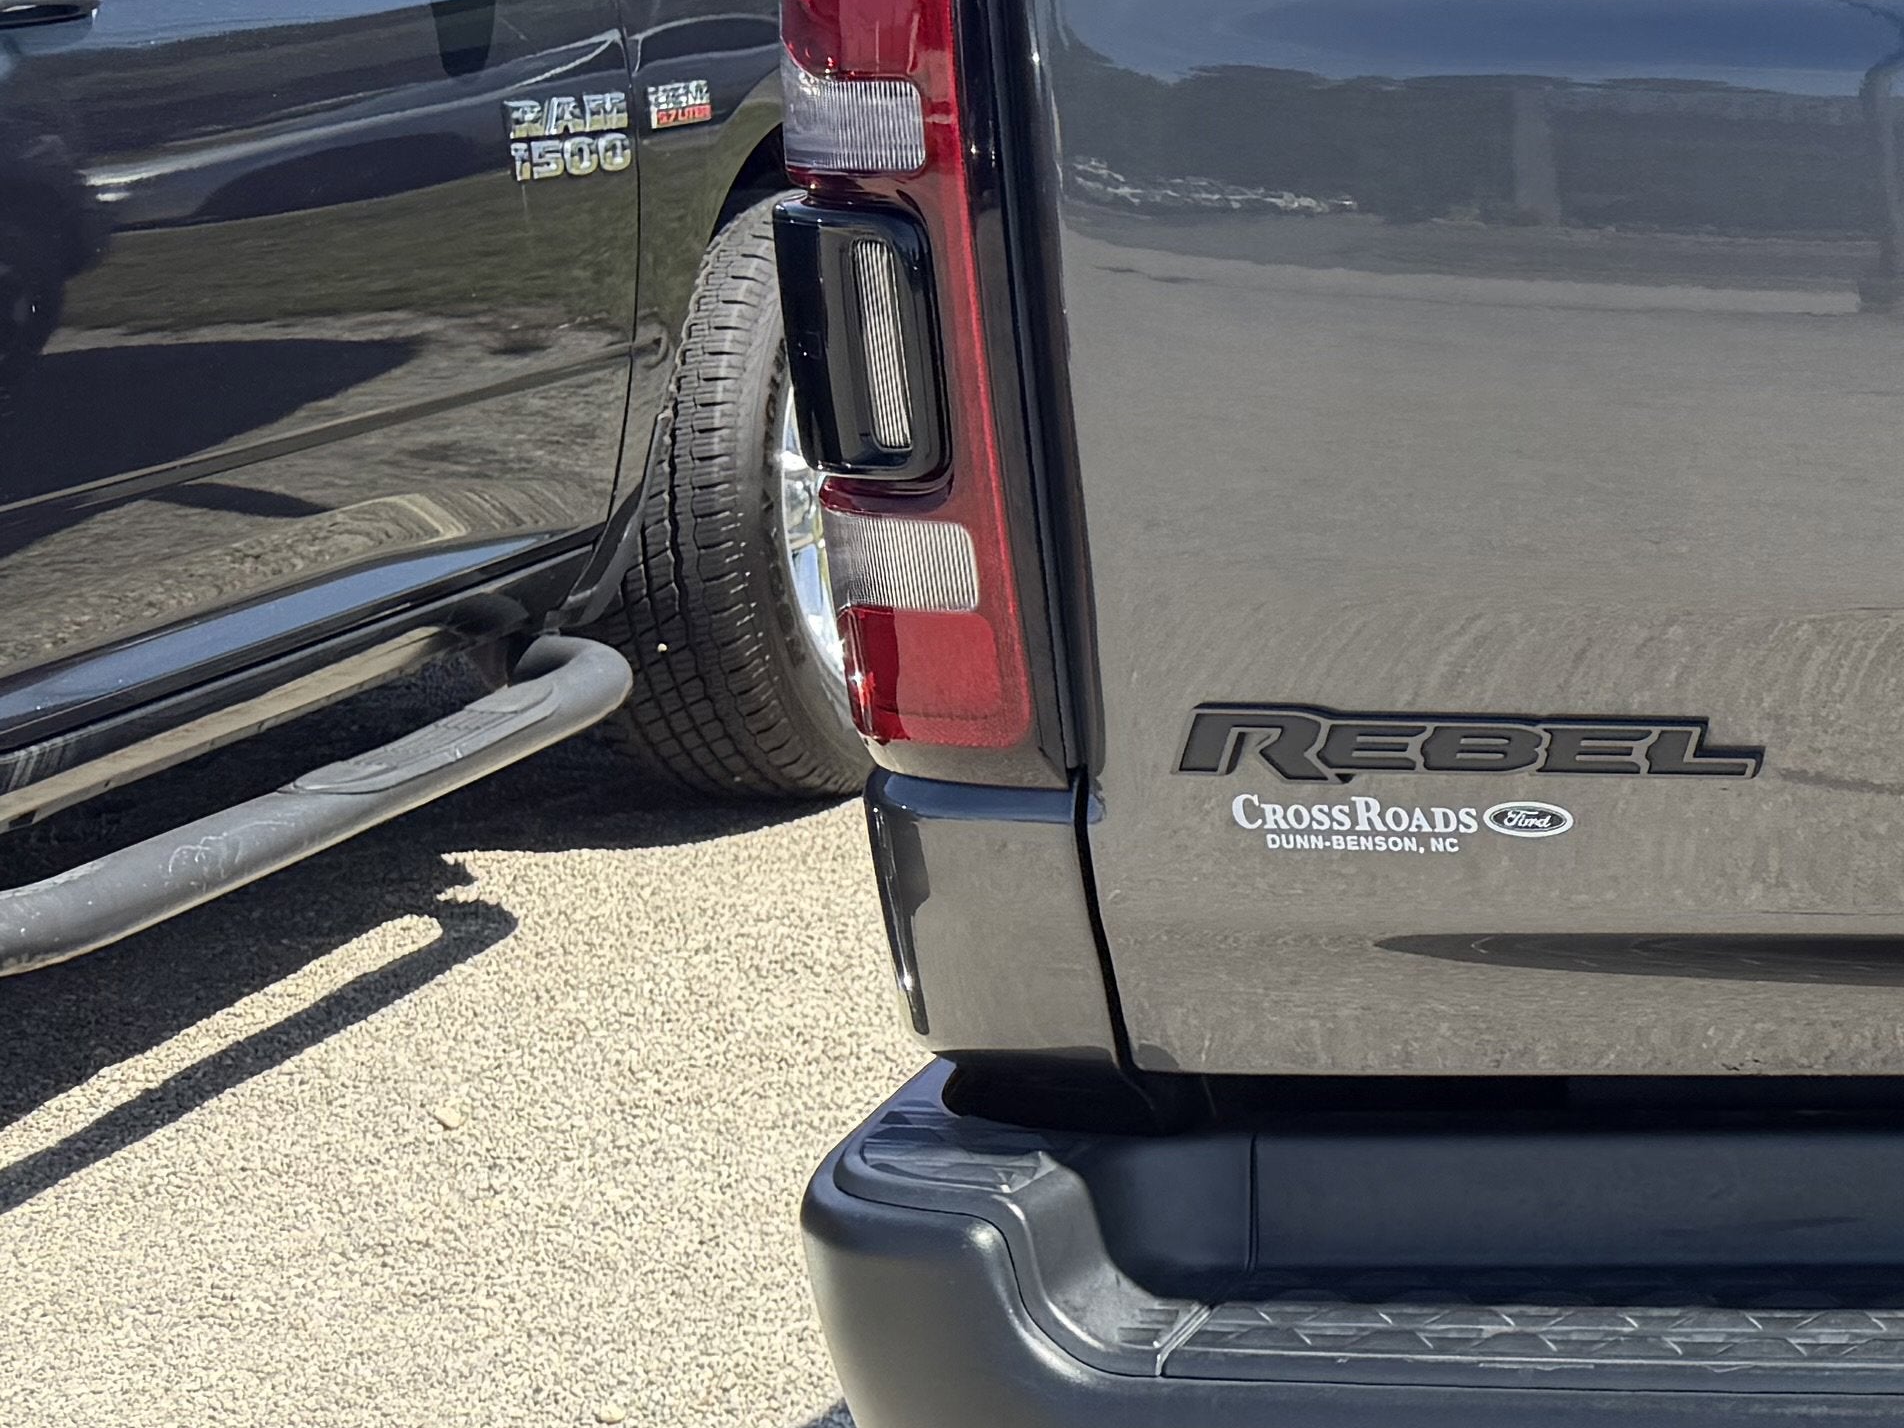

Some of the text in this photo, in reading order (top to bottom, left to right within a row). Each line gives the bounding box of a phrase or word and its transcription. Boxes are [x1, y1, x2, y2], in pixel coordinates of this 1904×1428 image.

[503, 92, 628, 139] RAM
[510, 132, 633, 182] 1500
[1177, 703, 1767, 784] REBEL
[1265, 833, 1460, 854] DUNN-BENSON, NC
